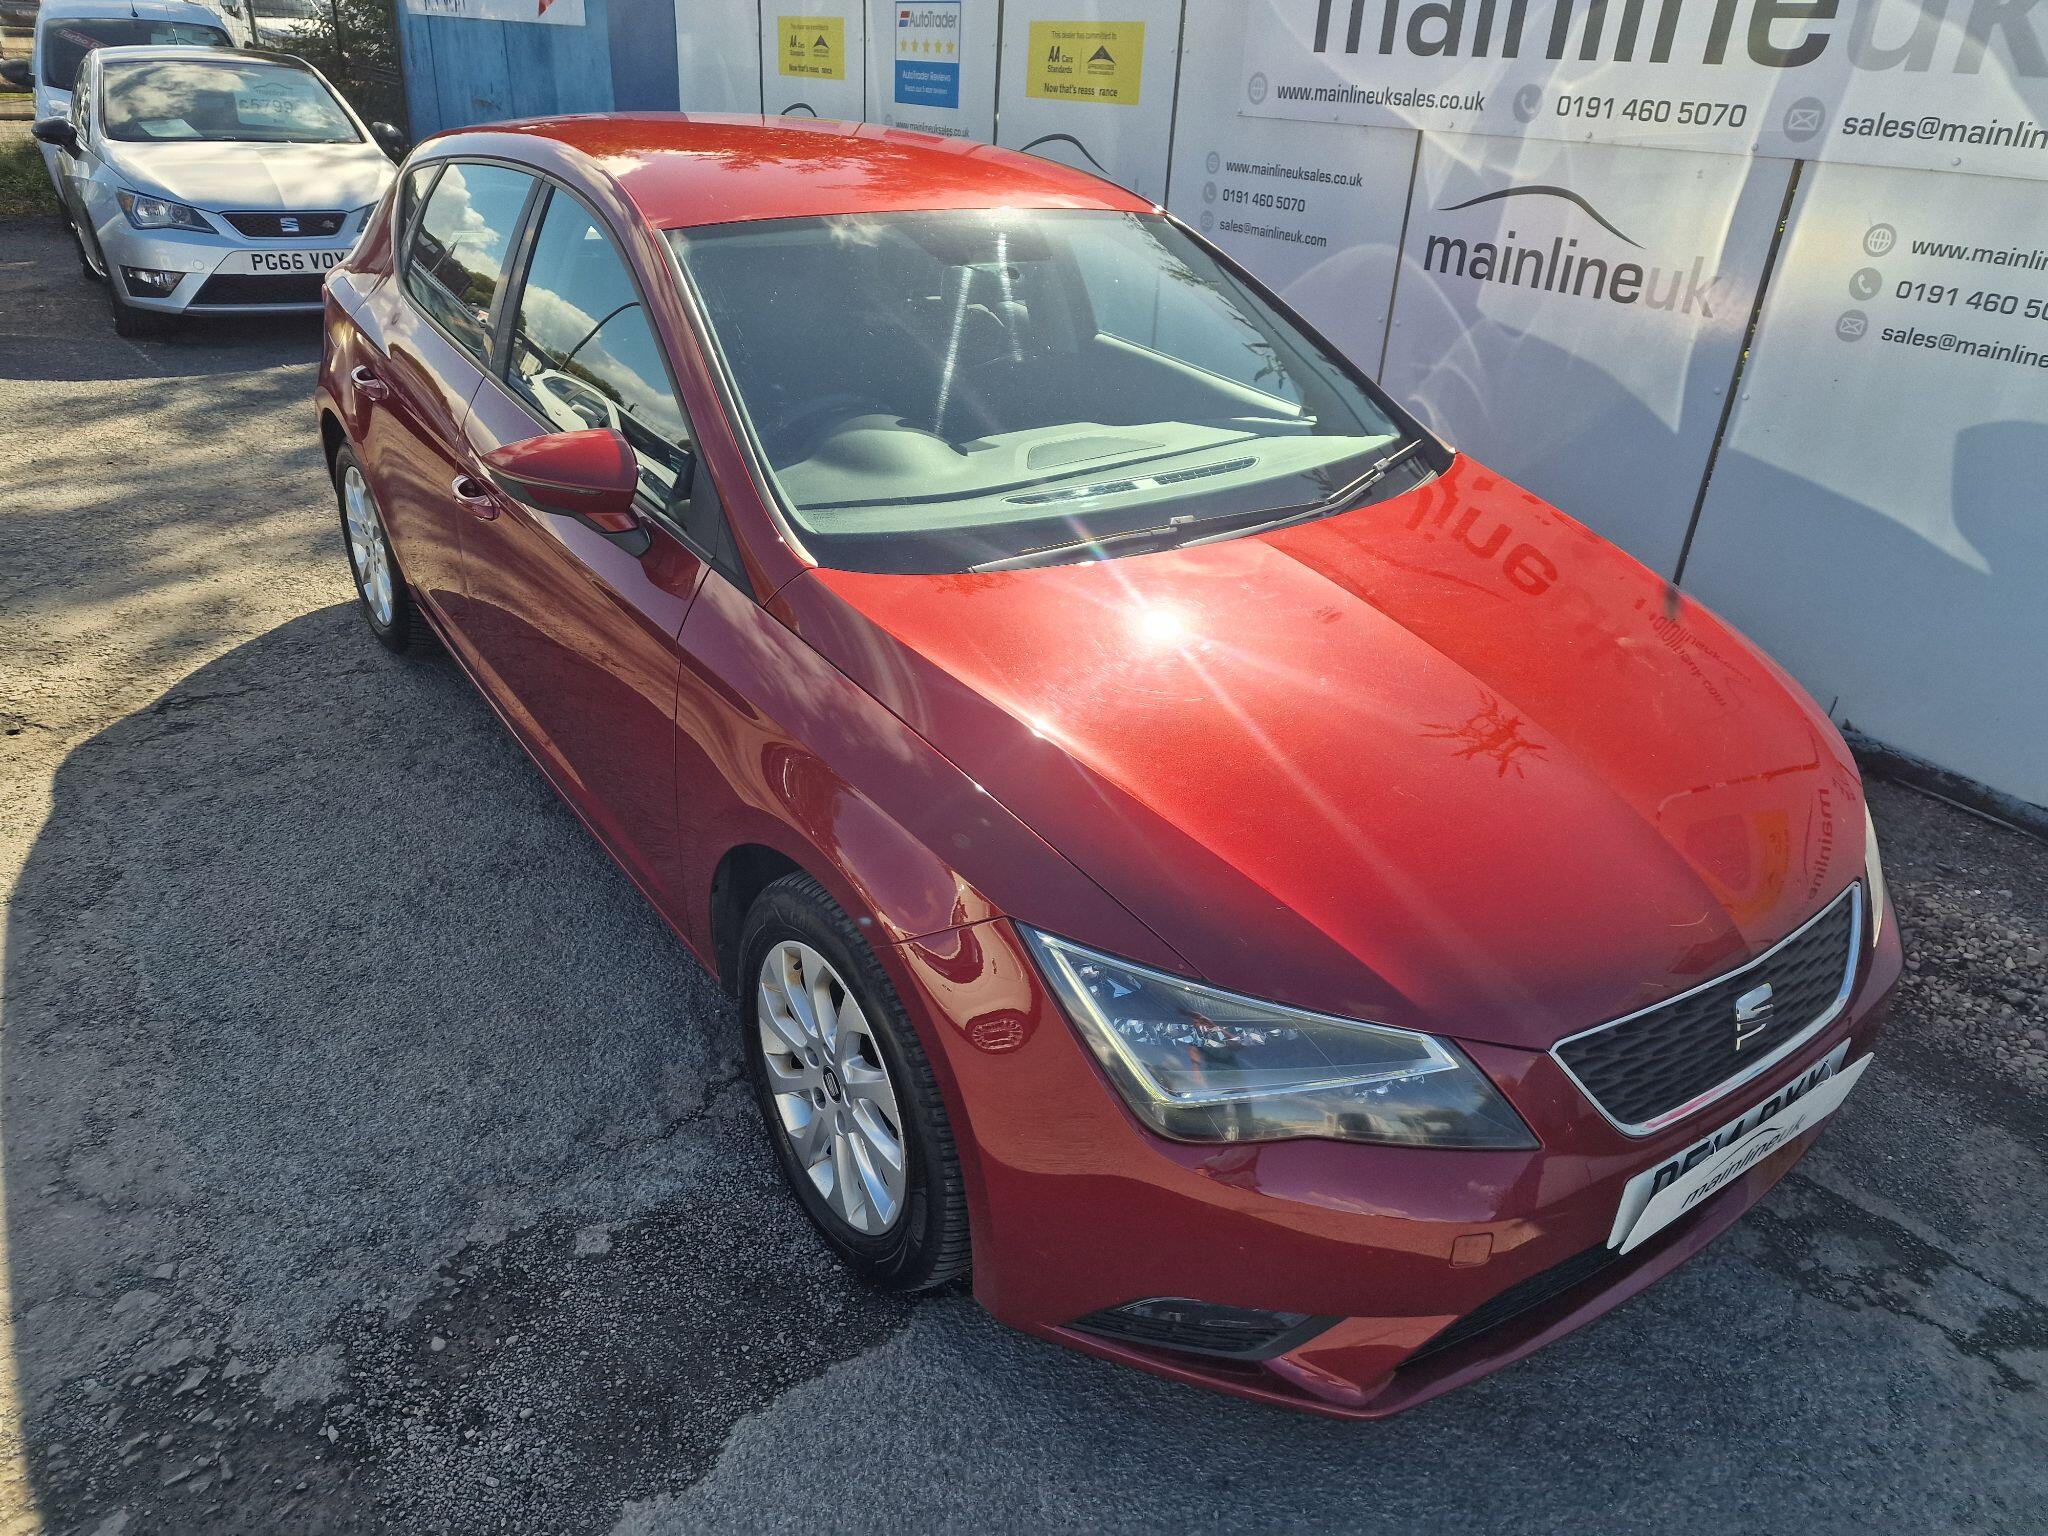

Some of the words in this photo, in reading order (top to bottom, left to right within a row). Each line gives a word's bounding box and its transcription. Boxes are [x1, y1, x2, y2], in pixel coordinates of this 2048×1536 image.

[909, 11, 958, 29] AutoTrader
[1048, 46, 1061, 63] AA
[1044, 83, 1059, 94] Now
[1059, 84, 1077, 95] that's
[1277, 83, 1485, 112] www.mainlineuksales.co.uk
[1556, 95, 1614, 121] 0191
[1622, 99, 1671, 123] 460
[1677, 102, 1747, 128] 5070
[1842, 112, 2048, 150] sales@mainlin
[1226, 160, 1363, 187] www.mainlineuksales.co.uk
[1222, 188, 1249, 205] 0191
[1252, 193, 1274, 208] 460
[1275, 196, 1306, 213] 5070
[1219, 219, 1328, 247] sales@mainlineuk.com
[251, 252, 305, 271] PG66
[1423, 230, 1721, 319] mainlineuk
[1895, 280, 1960, 306] 0191
[1965, 290, 2019, 315] 460
[1681, 1113, 1807, 1209] mainlineuk
